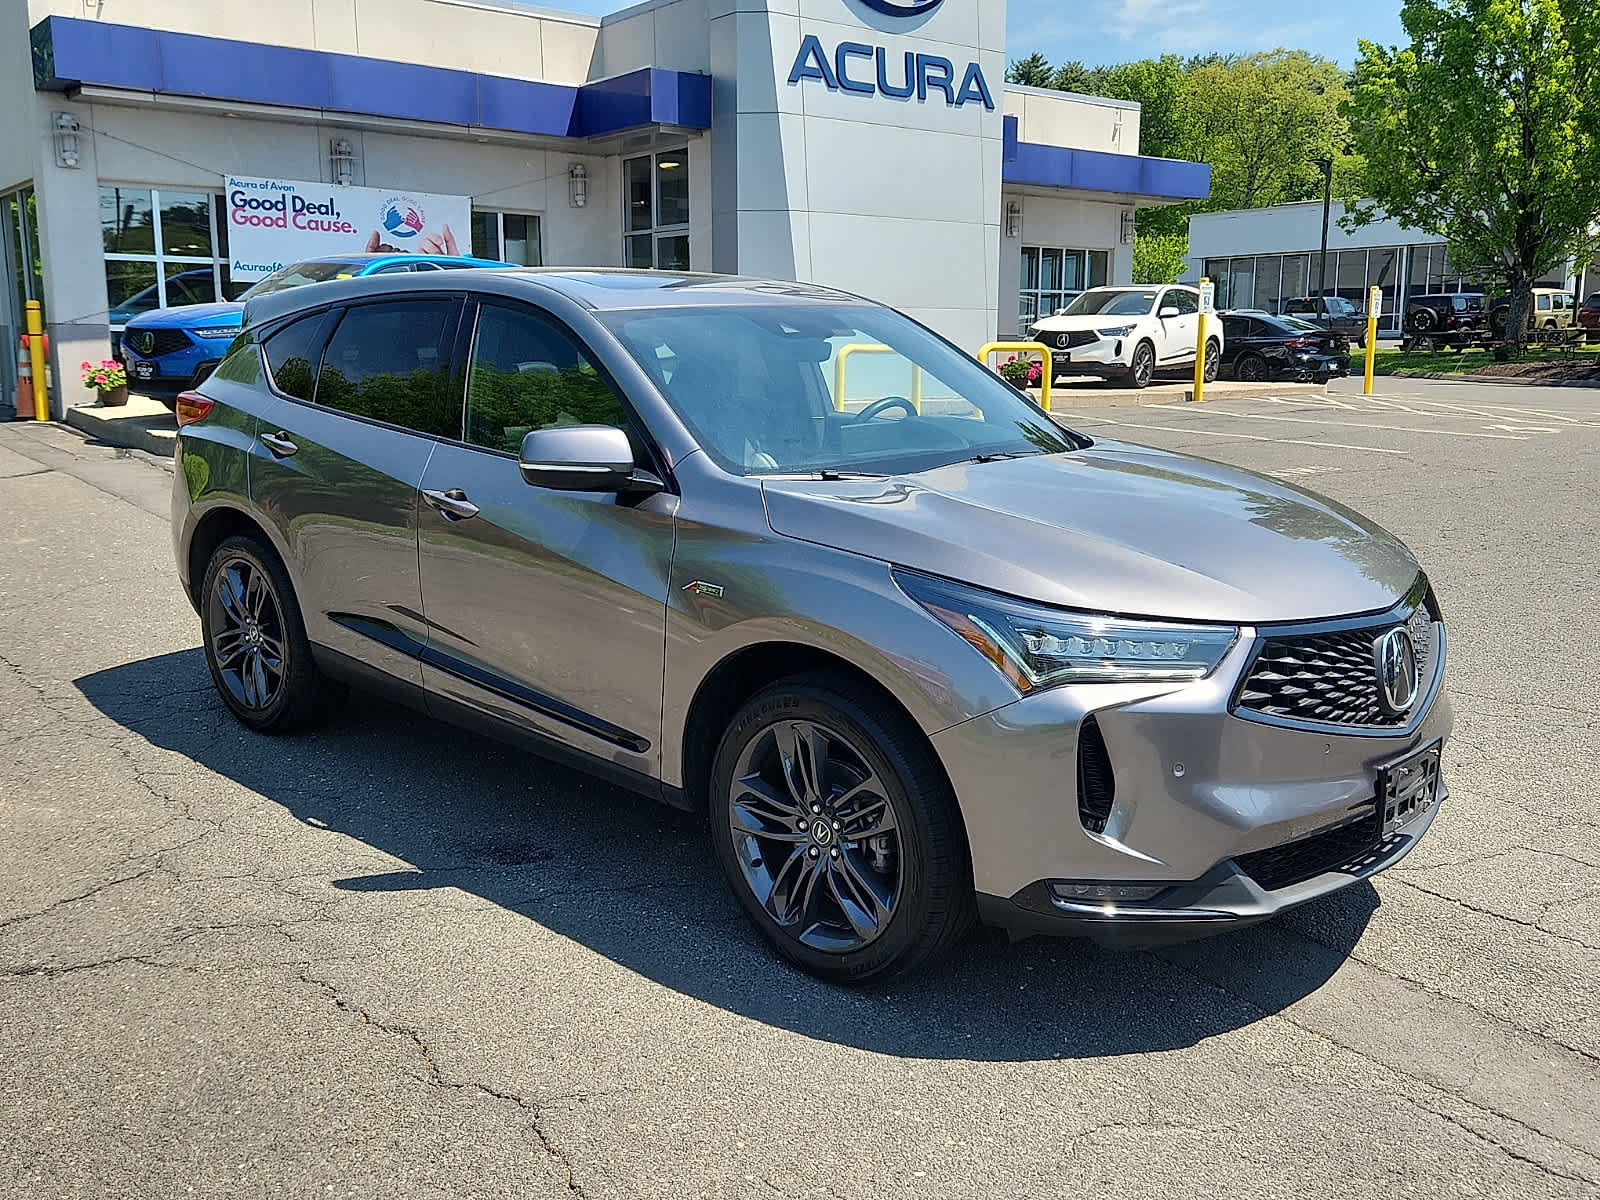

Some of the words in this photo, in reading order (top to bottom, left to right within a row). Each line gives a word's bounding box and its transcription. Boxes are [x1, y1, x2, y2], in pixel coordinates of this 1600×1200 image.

[787, 34, 995, 110] ACURA
[230, 178, 257, 189] Acura
[259, 180, 269, 190] of
[271, 181, 295, 192] Avon
[231, 190, 287, 212] Good
[292, 195, 341, 220] Deal,
[231, 207, 288, 229] Good
[292, 211, 358, 234] Cause.
